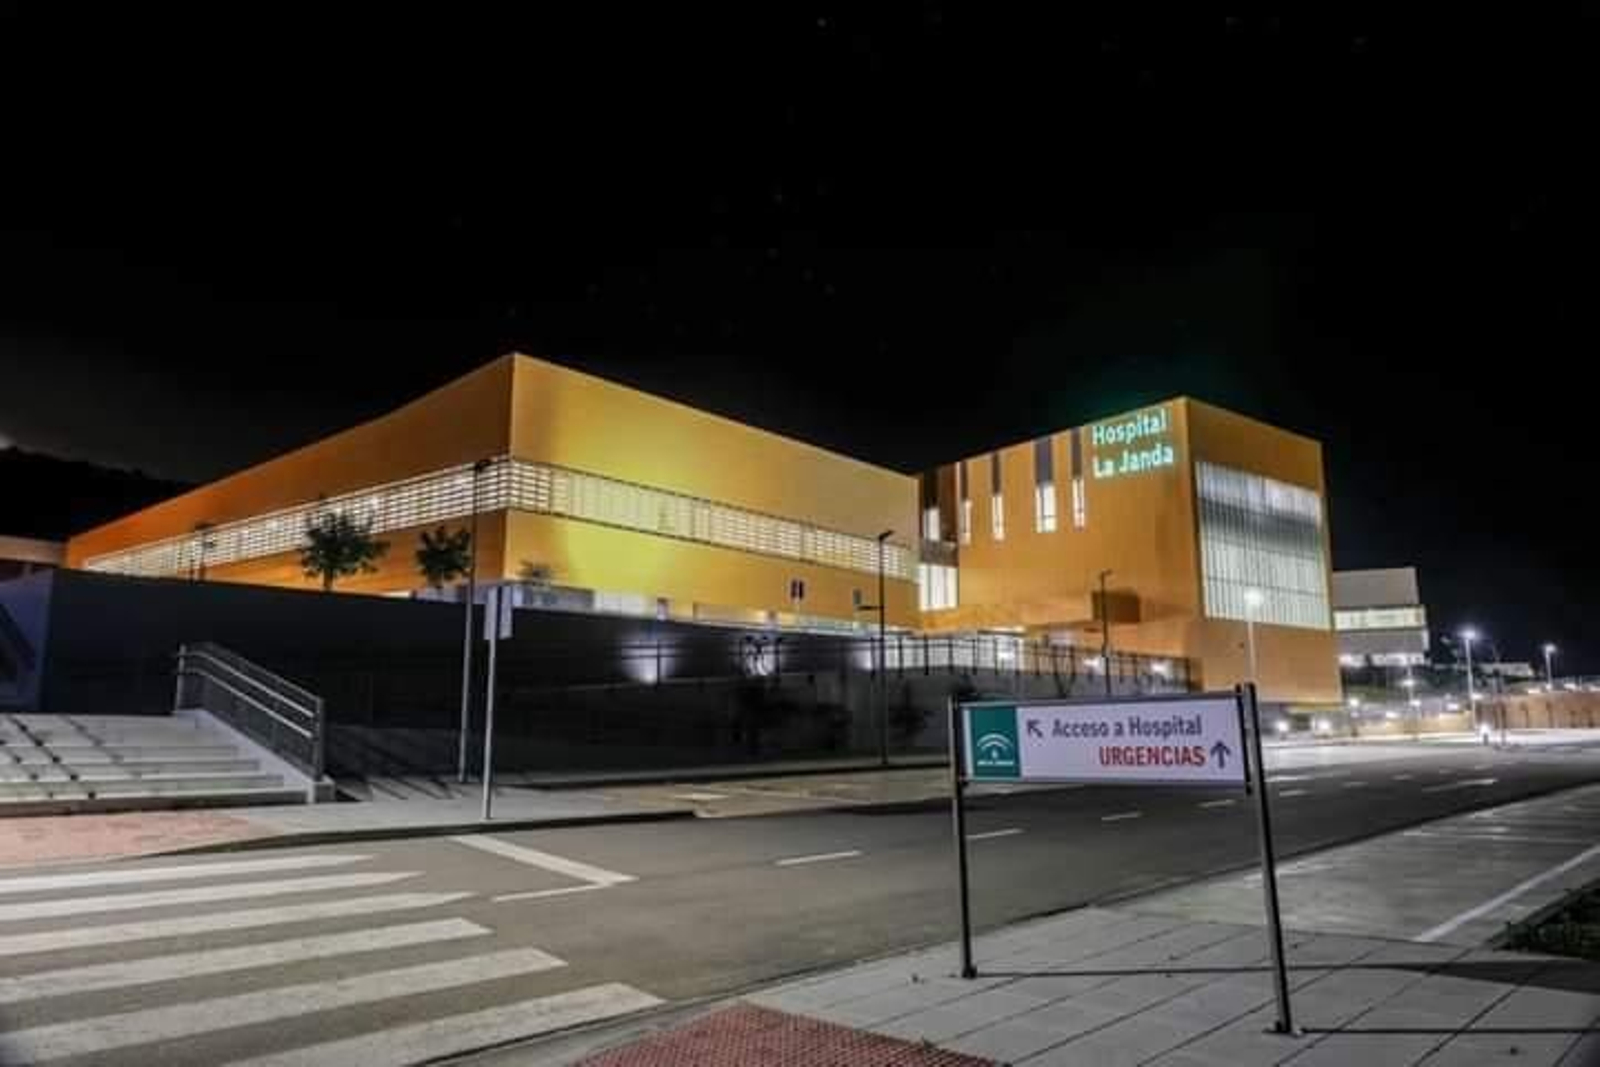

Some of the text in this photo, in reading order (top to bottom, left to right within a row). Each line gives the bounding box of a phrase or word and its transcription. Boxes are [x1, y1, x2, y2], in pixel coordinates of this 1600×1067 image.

[1092, 407, 1167, 444] Hospital
[1093, 443, 1174, 478] La Janda
[1052, 714, 1202, 740] Acceso a Hospital
[1099, 745, 1206, 767] URGENCIAS
